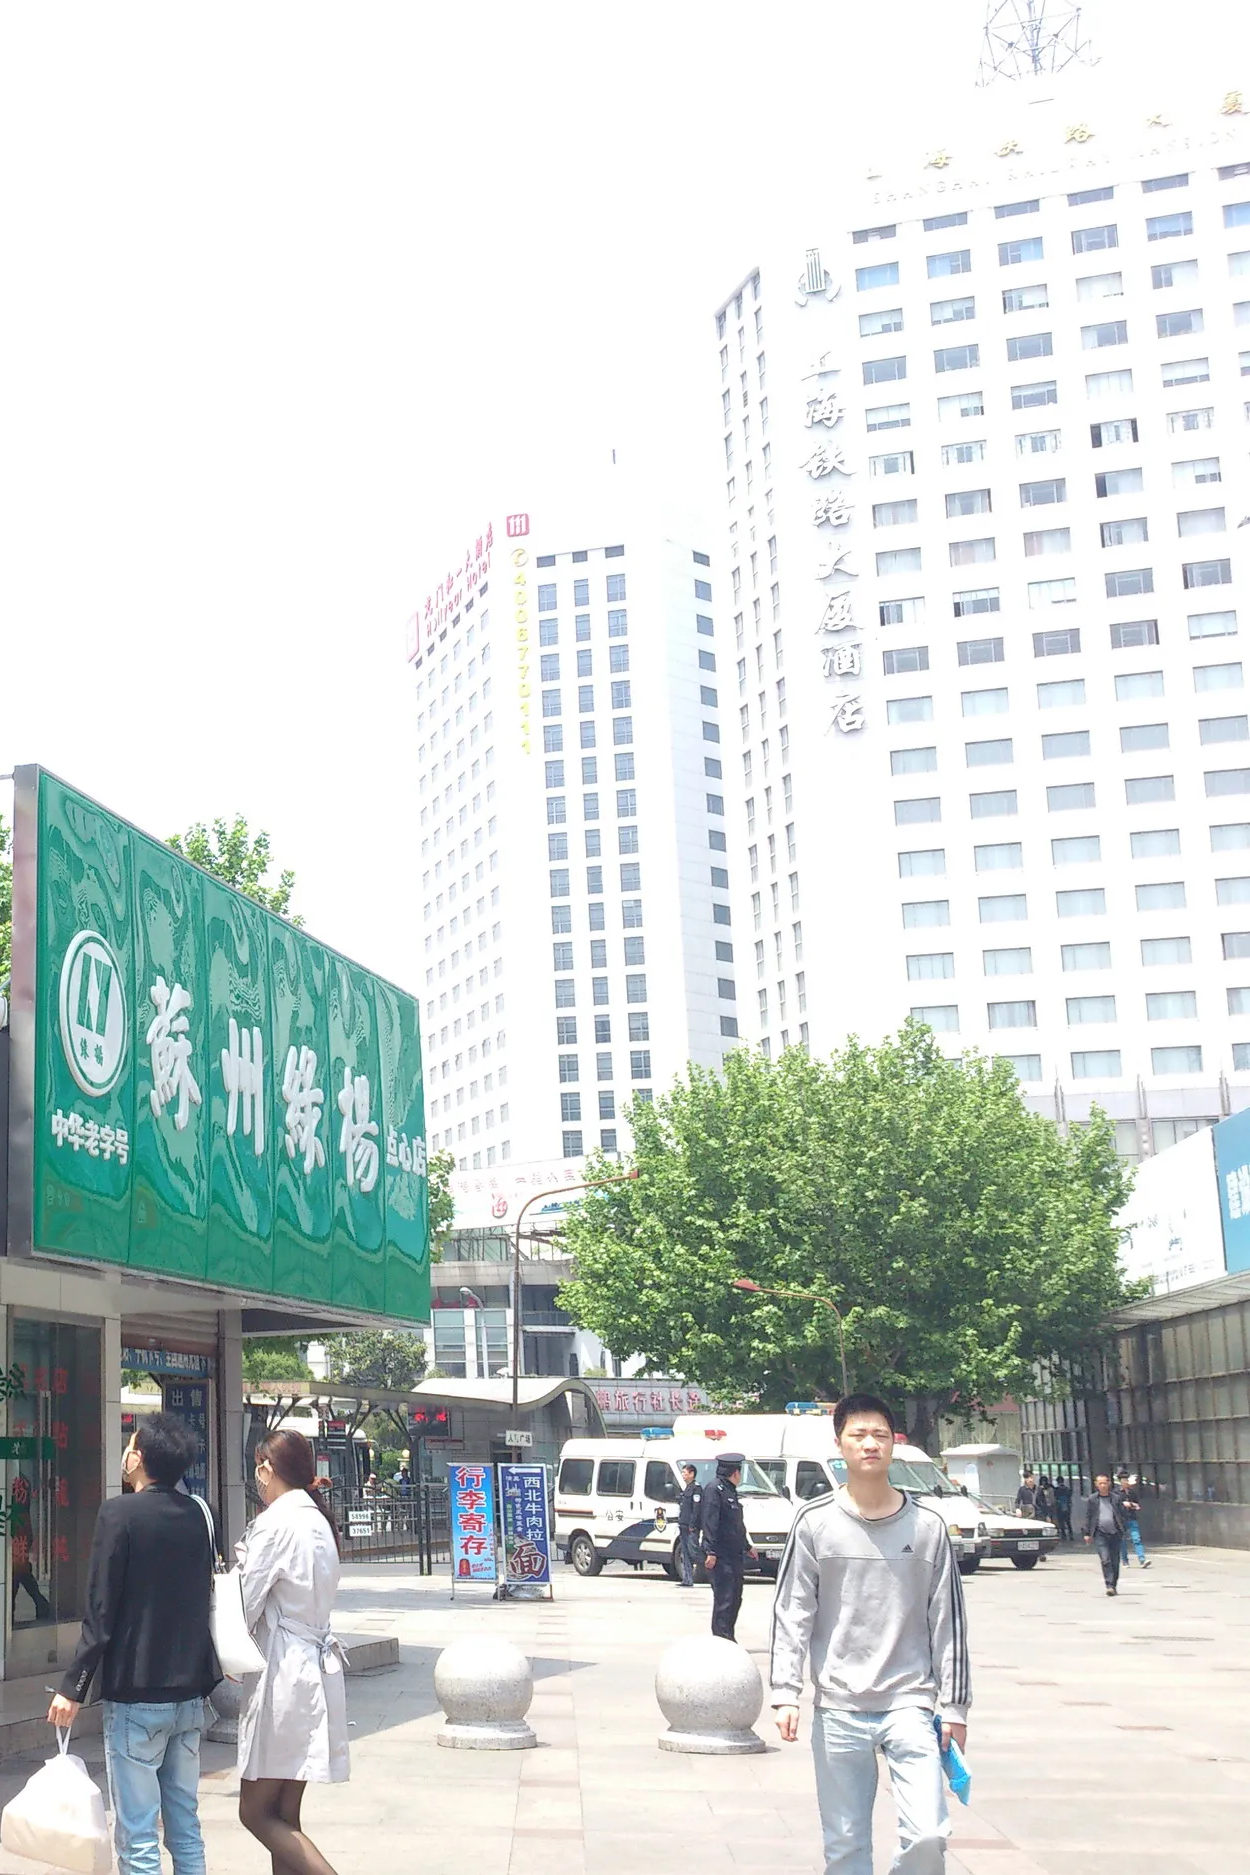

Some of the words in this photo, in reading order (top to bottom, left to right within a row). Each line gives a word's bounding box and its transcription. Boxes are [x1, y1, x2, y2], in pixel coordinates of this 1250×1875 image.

[51, 1108, 130, 1166] 中华老字号
[455, 1466, 489, 1556] 行李寄存
[604, 1508, 625, 1523] 公安
